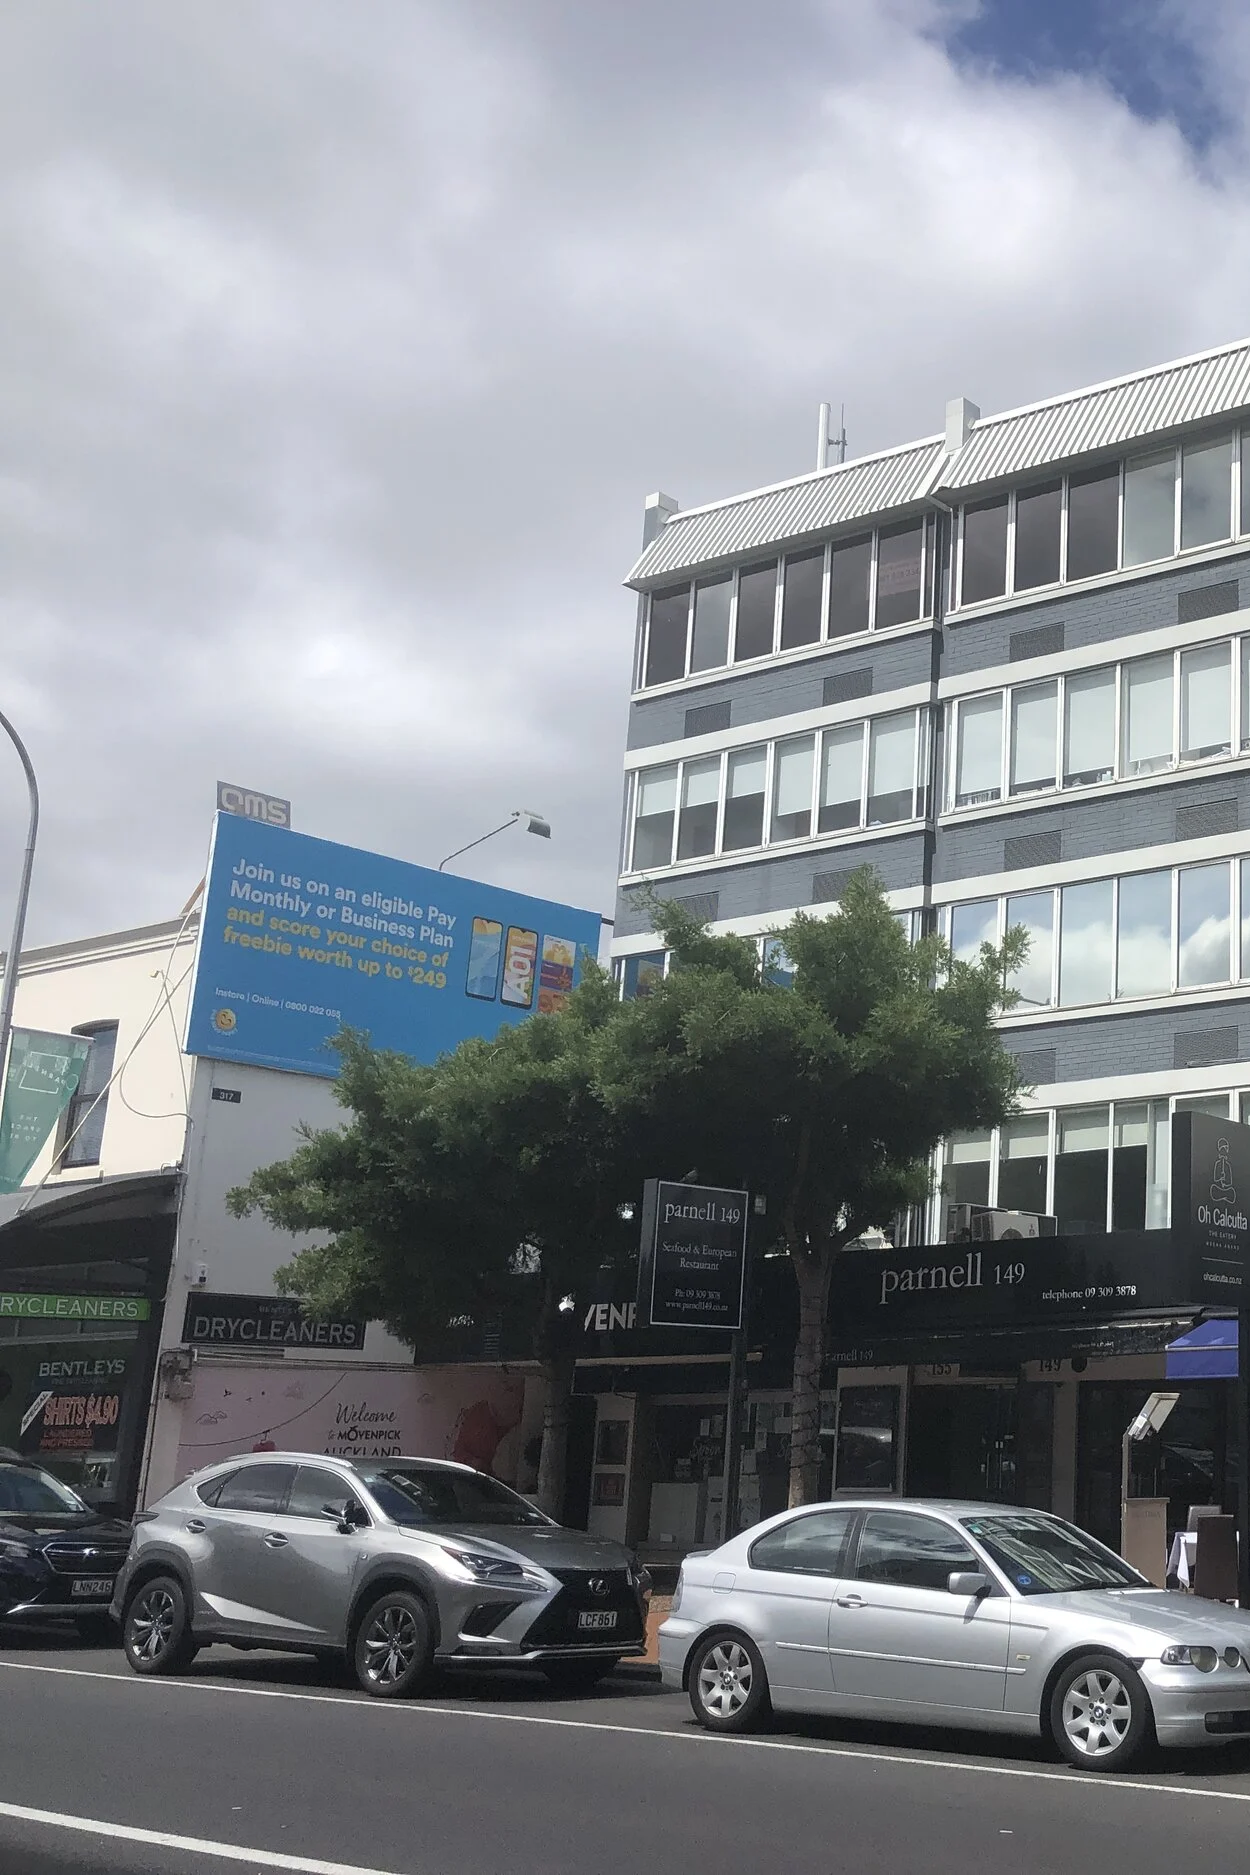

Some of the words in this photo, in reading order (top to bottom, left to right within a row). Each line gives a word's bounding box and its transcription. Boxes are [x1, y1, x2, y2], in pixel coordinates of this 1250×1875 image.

[232, 859, 275, 883] Join
[280, 873, 301, 890] us
[306, 880, 329, 896] on
[334, 887, 356, 903] an
[361, 891, 423, 919] eligible
[427, 906, 457, 931] Pay
[230, 880, 312, 917] Monthly
[316, 905, 336, 920] or
[341, 905, 415, 939] Business
[420, 925, 454, 948] Plan
[226, 906, 265, 926] and
[269, 916, 320, 939] score
[326, 928, 367, 949] your
[371, 937, 427, 963] choice
[431, 951, 449, 968] of
[223, 925, 292, 956] freebie
[298, 946, 353, 968] worth
[357, 959, 380, 977] up
[385, 962, 403, 979] to
[408, 966, 447, 989] $249
[215, 987, 245, 1000] Instore
[251, 994, 279, 1007] Online
[285, 1001, 308, 1012] 0800
[219, 1092, 234, 1101] 317
[664, 1202, 716, 1224] parnell
[720, 1207, 740, 1224] 149
[1198, 1205, 1211, 1224] Oh
[1213, 1208, 1248, 1230] Calcutta
[662, 1241, 691, 1254] Seafood
[702, 1244, 737, 1260] European
[680, 1258, 719, 1271] Restaurant
[879, 1252, 983, 1304] parnell
[994, 1262, 1025, 1285] 149
[1042, 1288, 1084, 1302] telephone
[1085, 1287, 1096, 1298] 09
[1098, 1286, 1114, 1298] 309
[1115, 1285, 1137, 1296] 3878
[193, 1316, 356, 1344] DRYCLEANERS
[38, 1359, 126, 1377] BENTLEYS
[43, 1395, 86, 1426] SHIRTS
[336, 1402, 397, 1424] Welcome
[579, 1613, 615, 1627] LCF861
